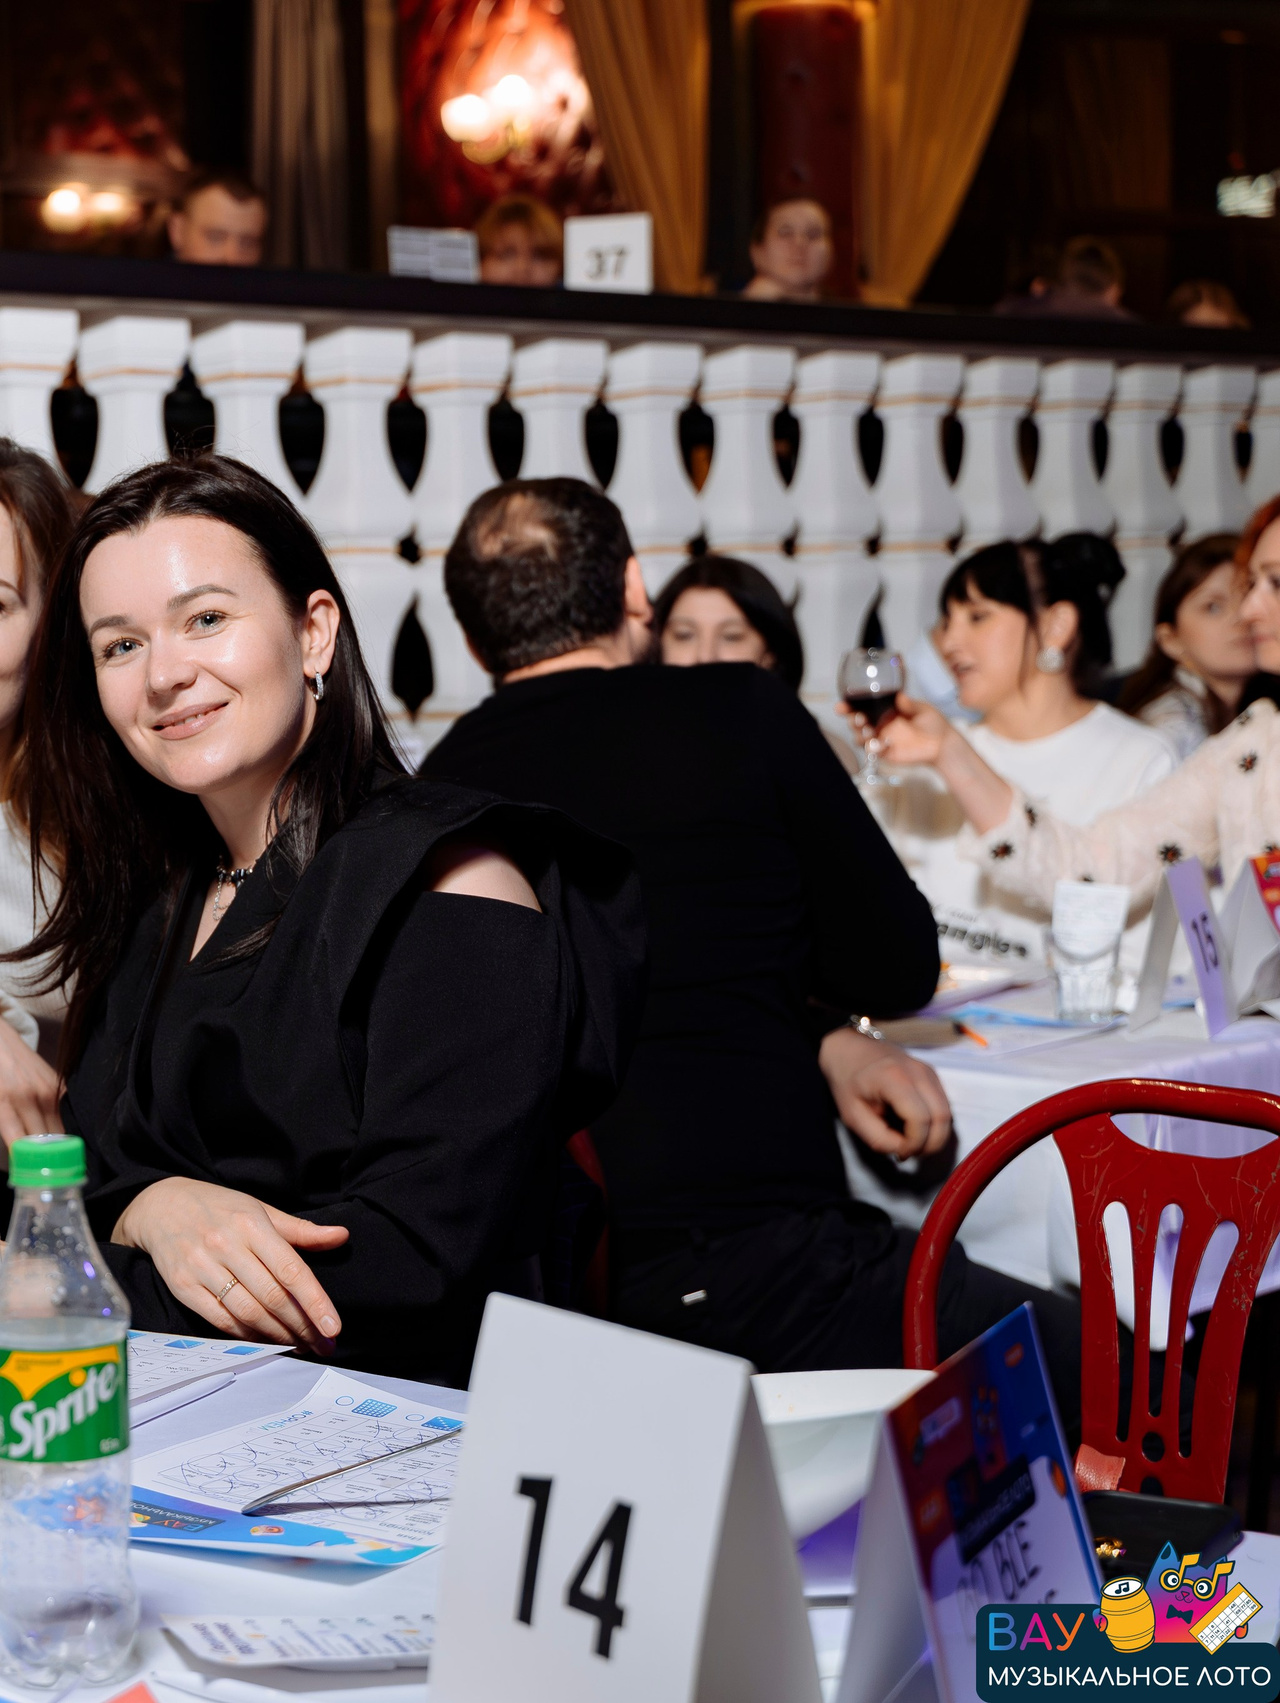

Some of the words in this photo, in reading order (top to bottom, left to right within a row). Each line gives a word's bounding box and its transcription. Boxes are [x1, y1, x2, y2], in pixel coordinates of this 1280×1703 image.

[1191, 911, 1219, 974] 15
[7, 1362, 118, 1460] Sprite
[515, 1474, 634, 1660] 14
